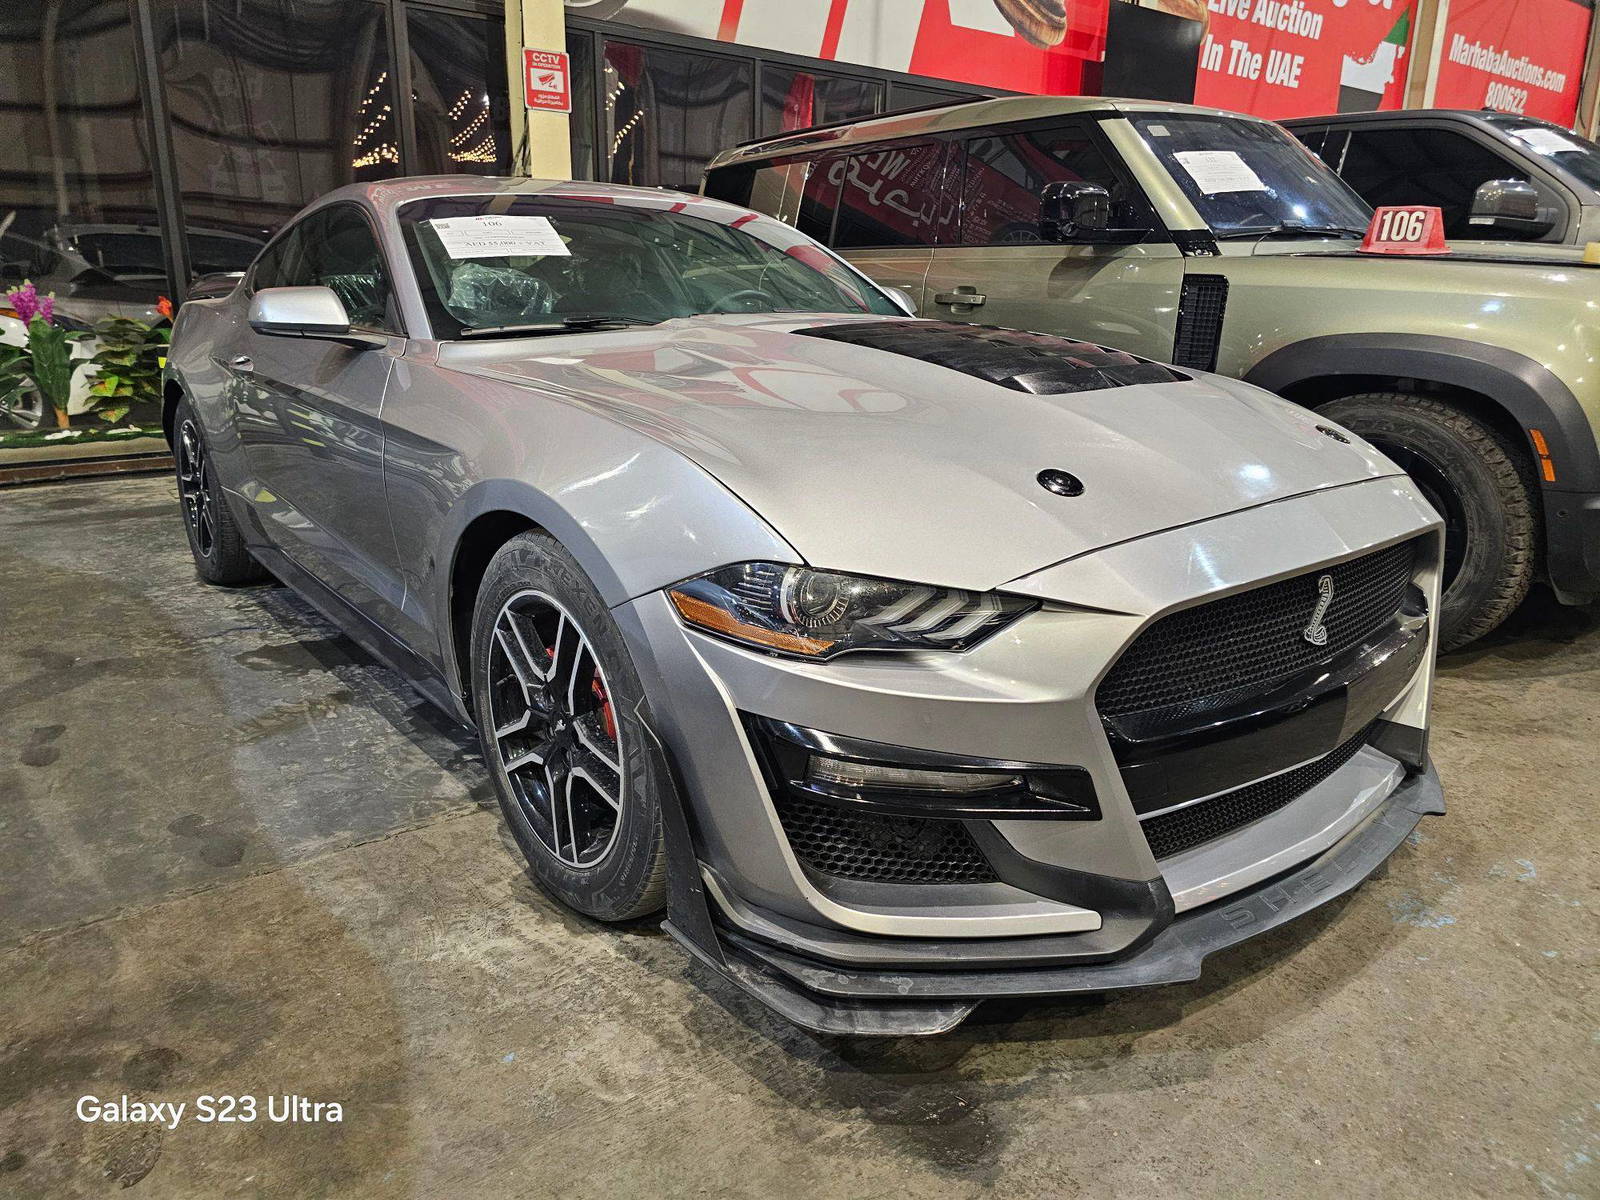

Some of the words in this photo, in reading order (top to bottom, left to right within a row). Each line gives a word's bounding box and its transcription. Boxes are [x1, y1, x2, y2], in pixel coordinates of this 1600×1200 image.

[1251, 0, 1324, 40] Auction
[532, 52, 560, 65] CCTV
[1200, 33, 1224, 72] In
[1227, 39, 1262, 81] The
[1265, 49, 1305, 89] UAE
[1448, 33, 1567, 94] MarhabaAuctions.com
[1484, 81, 1528, 115] 800622
[1380, 210, 1426, 242] 106
